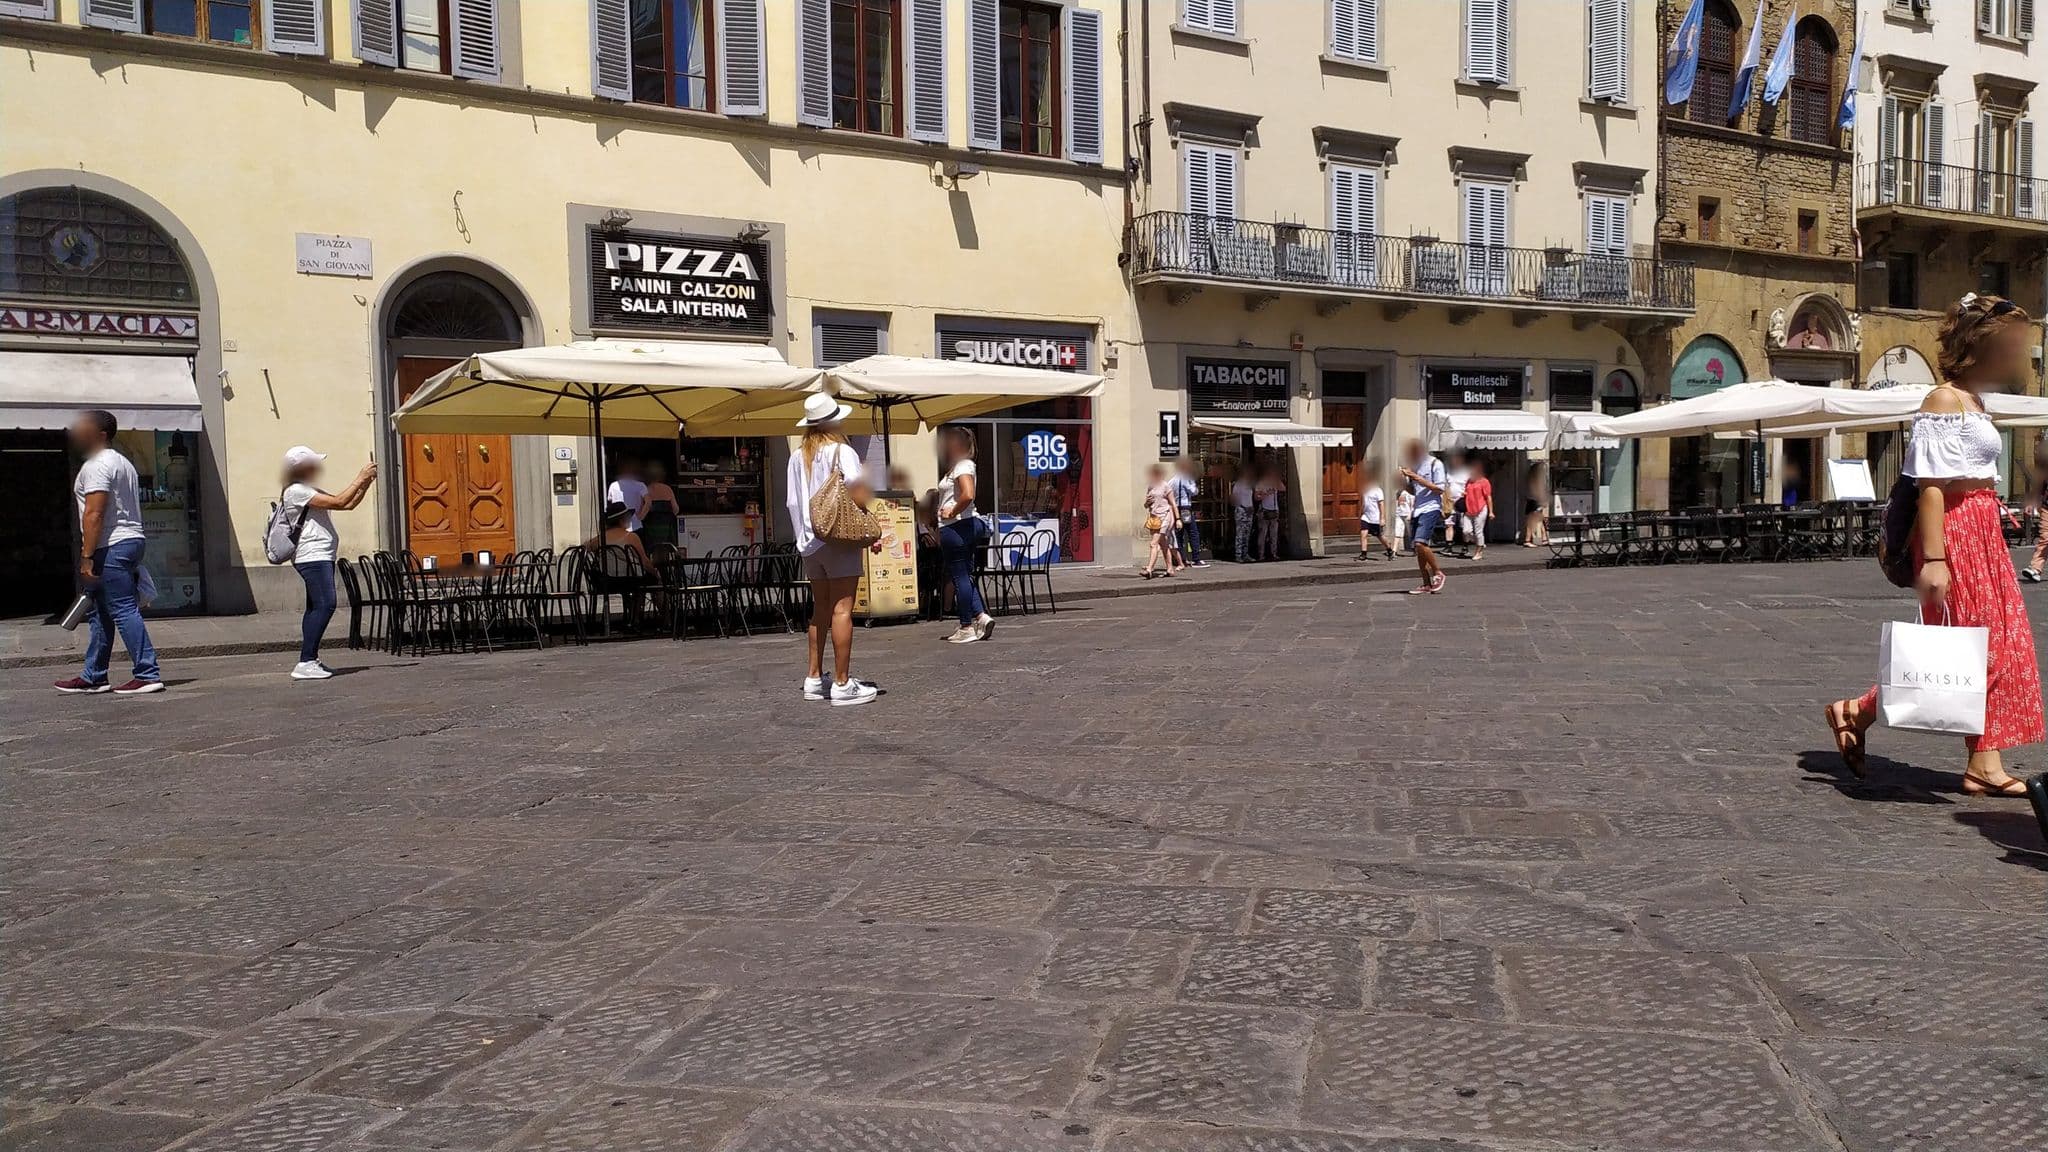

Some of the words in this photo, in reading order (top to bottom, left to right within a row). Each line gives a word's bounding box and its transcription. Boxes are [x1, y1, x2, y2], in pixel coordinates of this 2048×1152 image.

[315, 239, 352, 249] PIAZZA
[330, 250, 339, 258] DI
[605, 242, 760, 281] PIZZA
[299, 259, 320, 268] SAN
[325, 261, 370, 271] GIOVANNI
[610, 276, 671, 295] PANINI
[681, 281, 755, 300] CALZONI
[621, 297, 667, 314] SALA
[673, 300, 748, 319] INTERNA
[0, 309, 182, 336] ARMACIA
[954, 338, 1058, 366] swatch
[1194, 365, 1286, 386] TABACCHI
[1451, 374, 1508, 387] Brunelleschi
[1263, 400, 1288, 408] LOTTO
[1464, 391, 1495, 404] Bistrot
[1163, 415, 1176, 444] T
[1027, 434, 1067, 456] BIG
[1475, 434, 1510, 442] Restaurant
[1518, 434, 1529, 442] Bar
[1027, 456, 1067, 470] BOLD
[1902, 671, 1972, 687] KIKISIX
